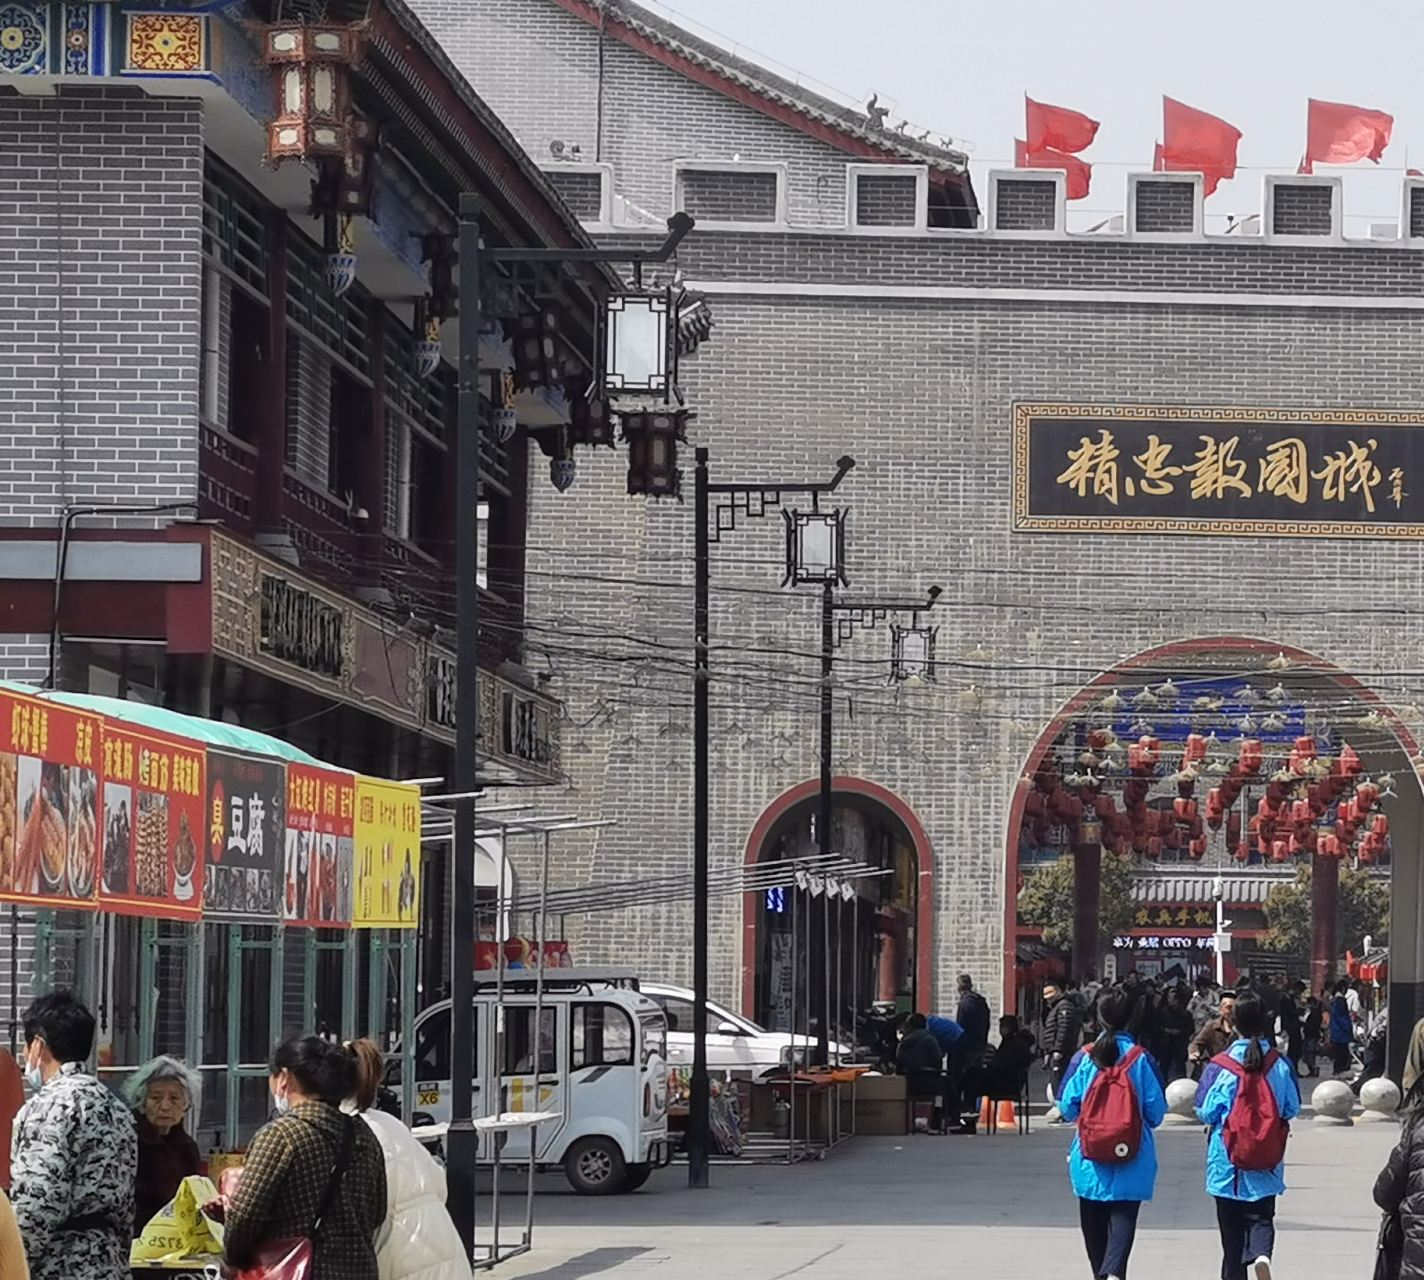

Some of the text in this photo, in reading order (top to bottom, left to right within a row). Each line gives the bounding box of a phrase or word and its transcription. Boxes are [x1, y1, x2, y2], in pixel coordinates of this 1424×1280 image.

[1055, 430, 1381, 513] 精忠報國城
[1162, 937, 1192, 948] OPPO
[419, 1092, 439, 1105] X6
